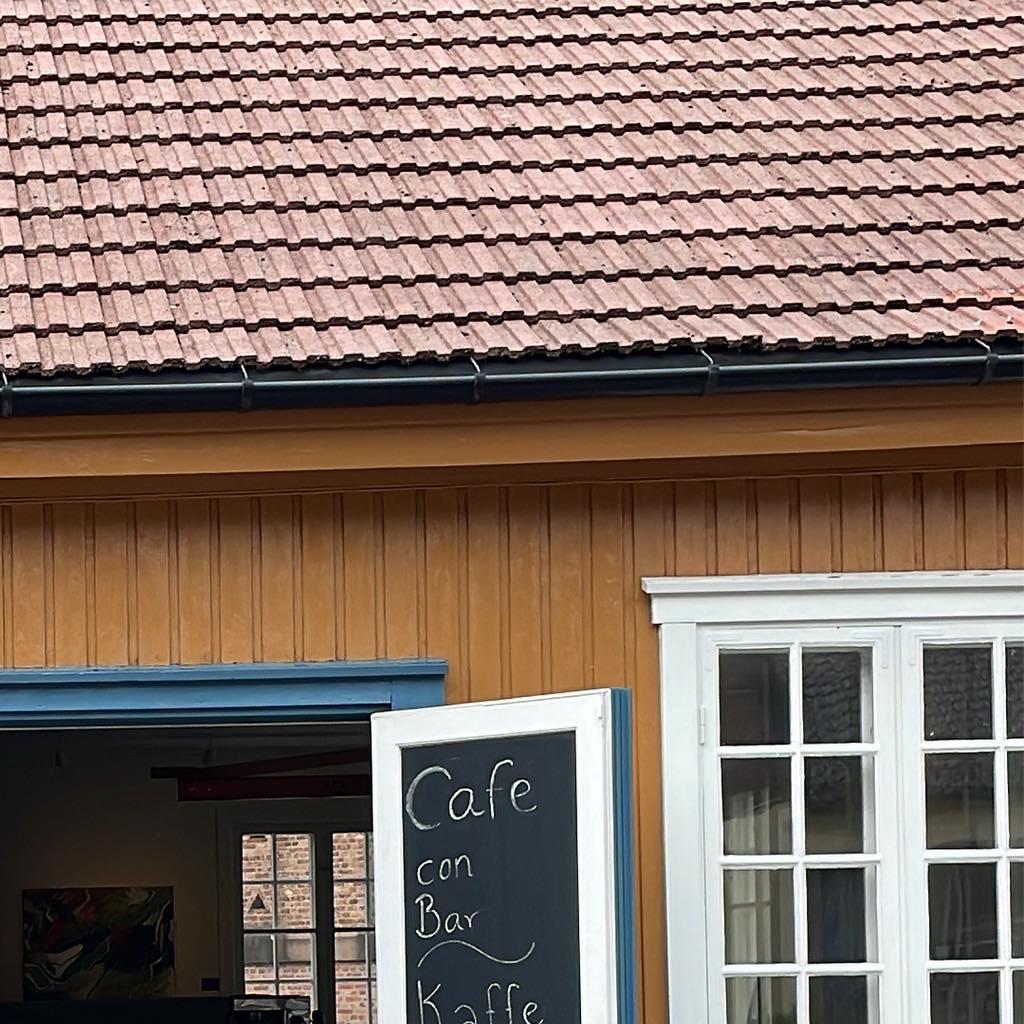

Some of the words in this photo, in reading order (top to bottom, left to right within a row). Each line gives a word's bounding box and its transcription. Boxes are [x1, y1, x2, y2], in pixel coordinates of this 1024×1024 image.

[405, 759, 537, 830] Cafe
[416, 854, 473, 886] con
[415, 892, 479, 939] Bar
